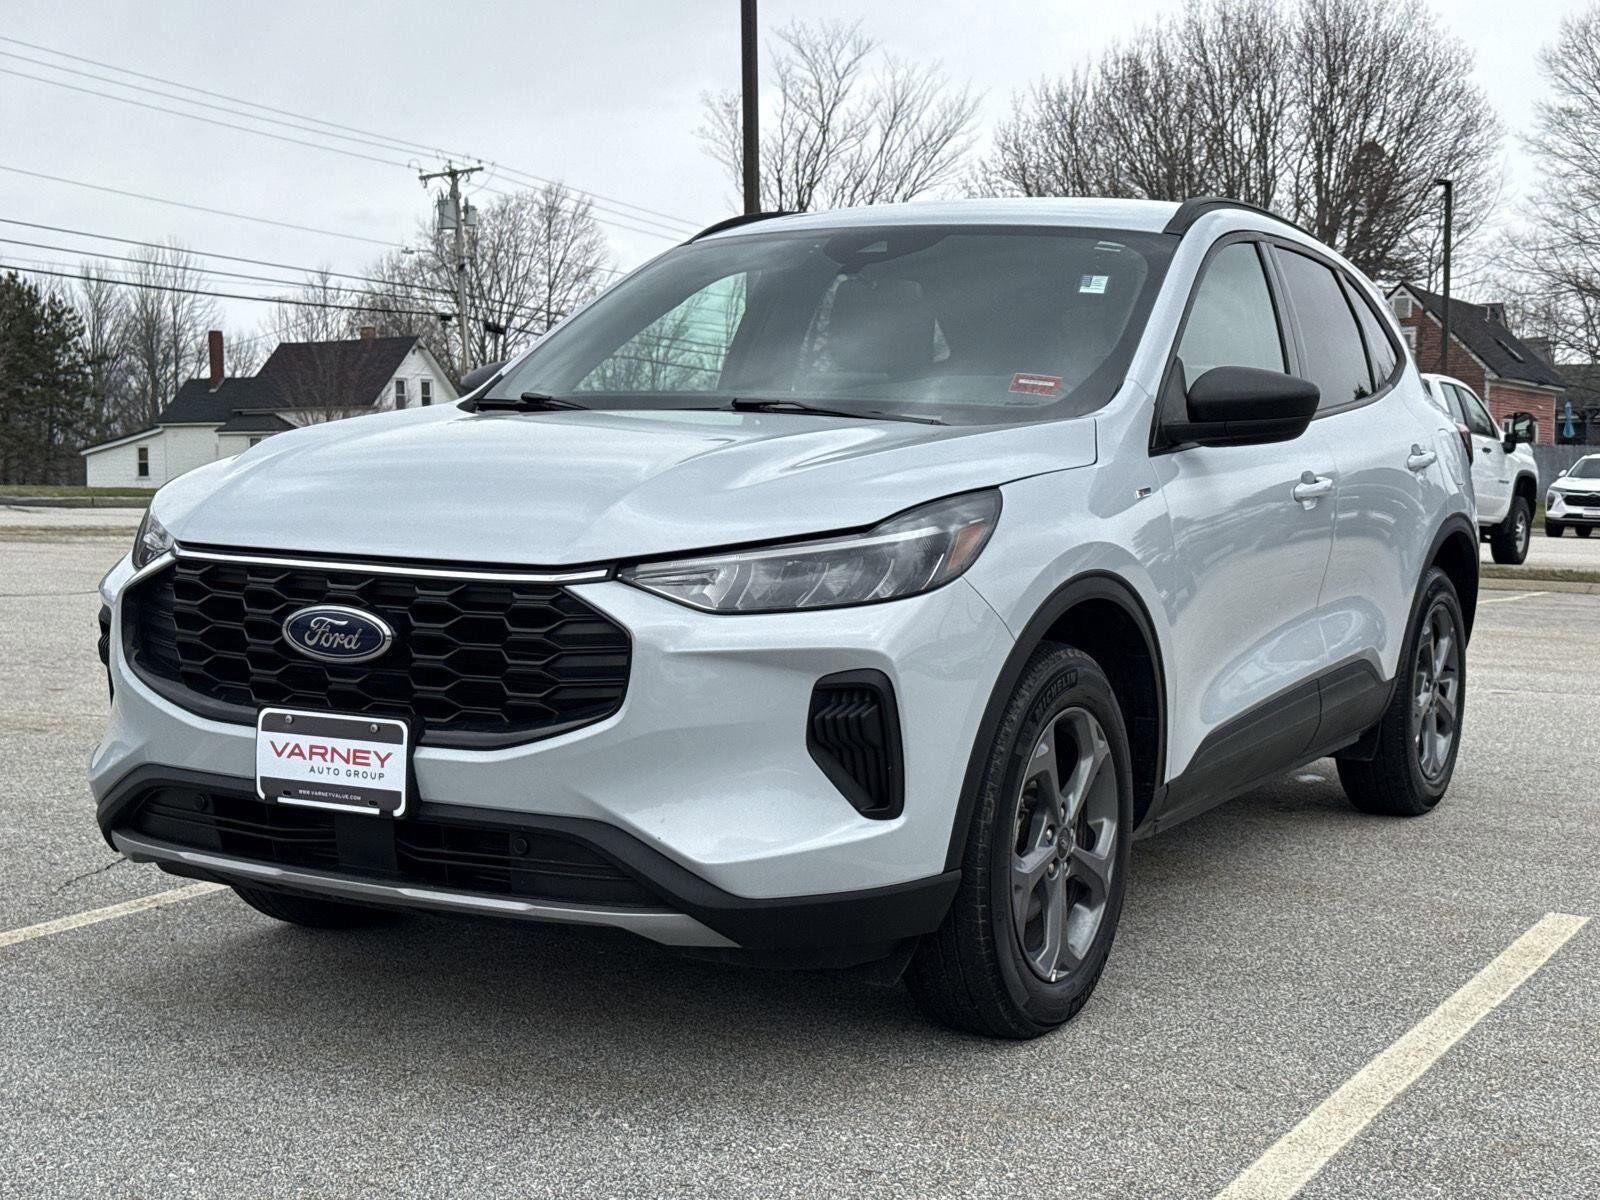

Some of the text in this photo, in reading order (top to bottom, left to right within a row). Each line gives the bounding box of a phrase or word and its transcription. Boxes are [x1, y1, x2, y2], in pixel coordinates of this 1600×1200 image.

[304, 616, 362, 650] Ford
[269, 740, 393, 768] VARNEY
[308, 765, 385, 781] AUTO GROUP
